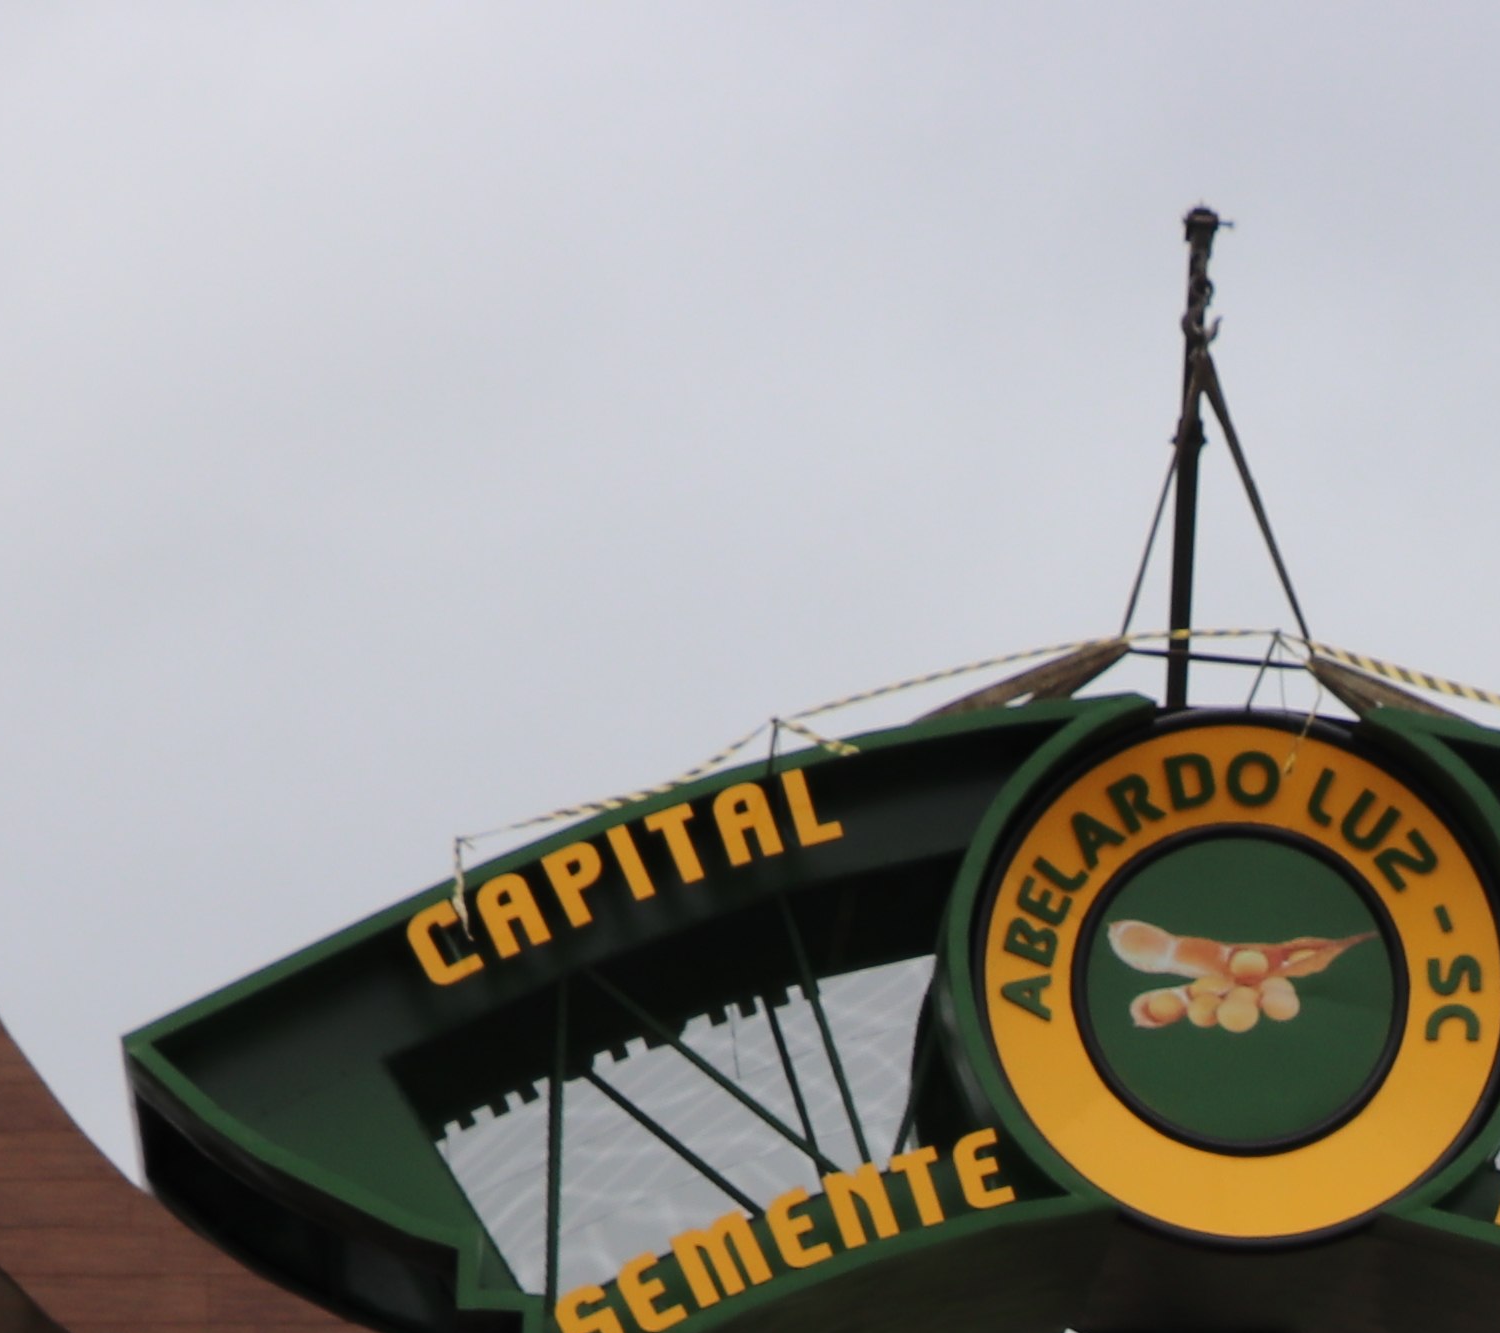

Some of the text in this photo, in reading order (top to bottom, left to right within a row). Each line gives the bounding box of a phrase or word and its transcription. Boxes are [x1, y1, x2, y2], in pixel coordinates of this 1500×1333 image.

[406, 768, 844, 986] CAPITAL
[1000, 750, 1280, 1022] ABELARDO
[1306, 768, 1438, 892] LUZ
[1425, 954, 1481, 1042] SC
